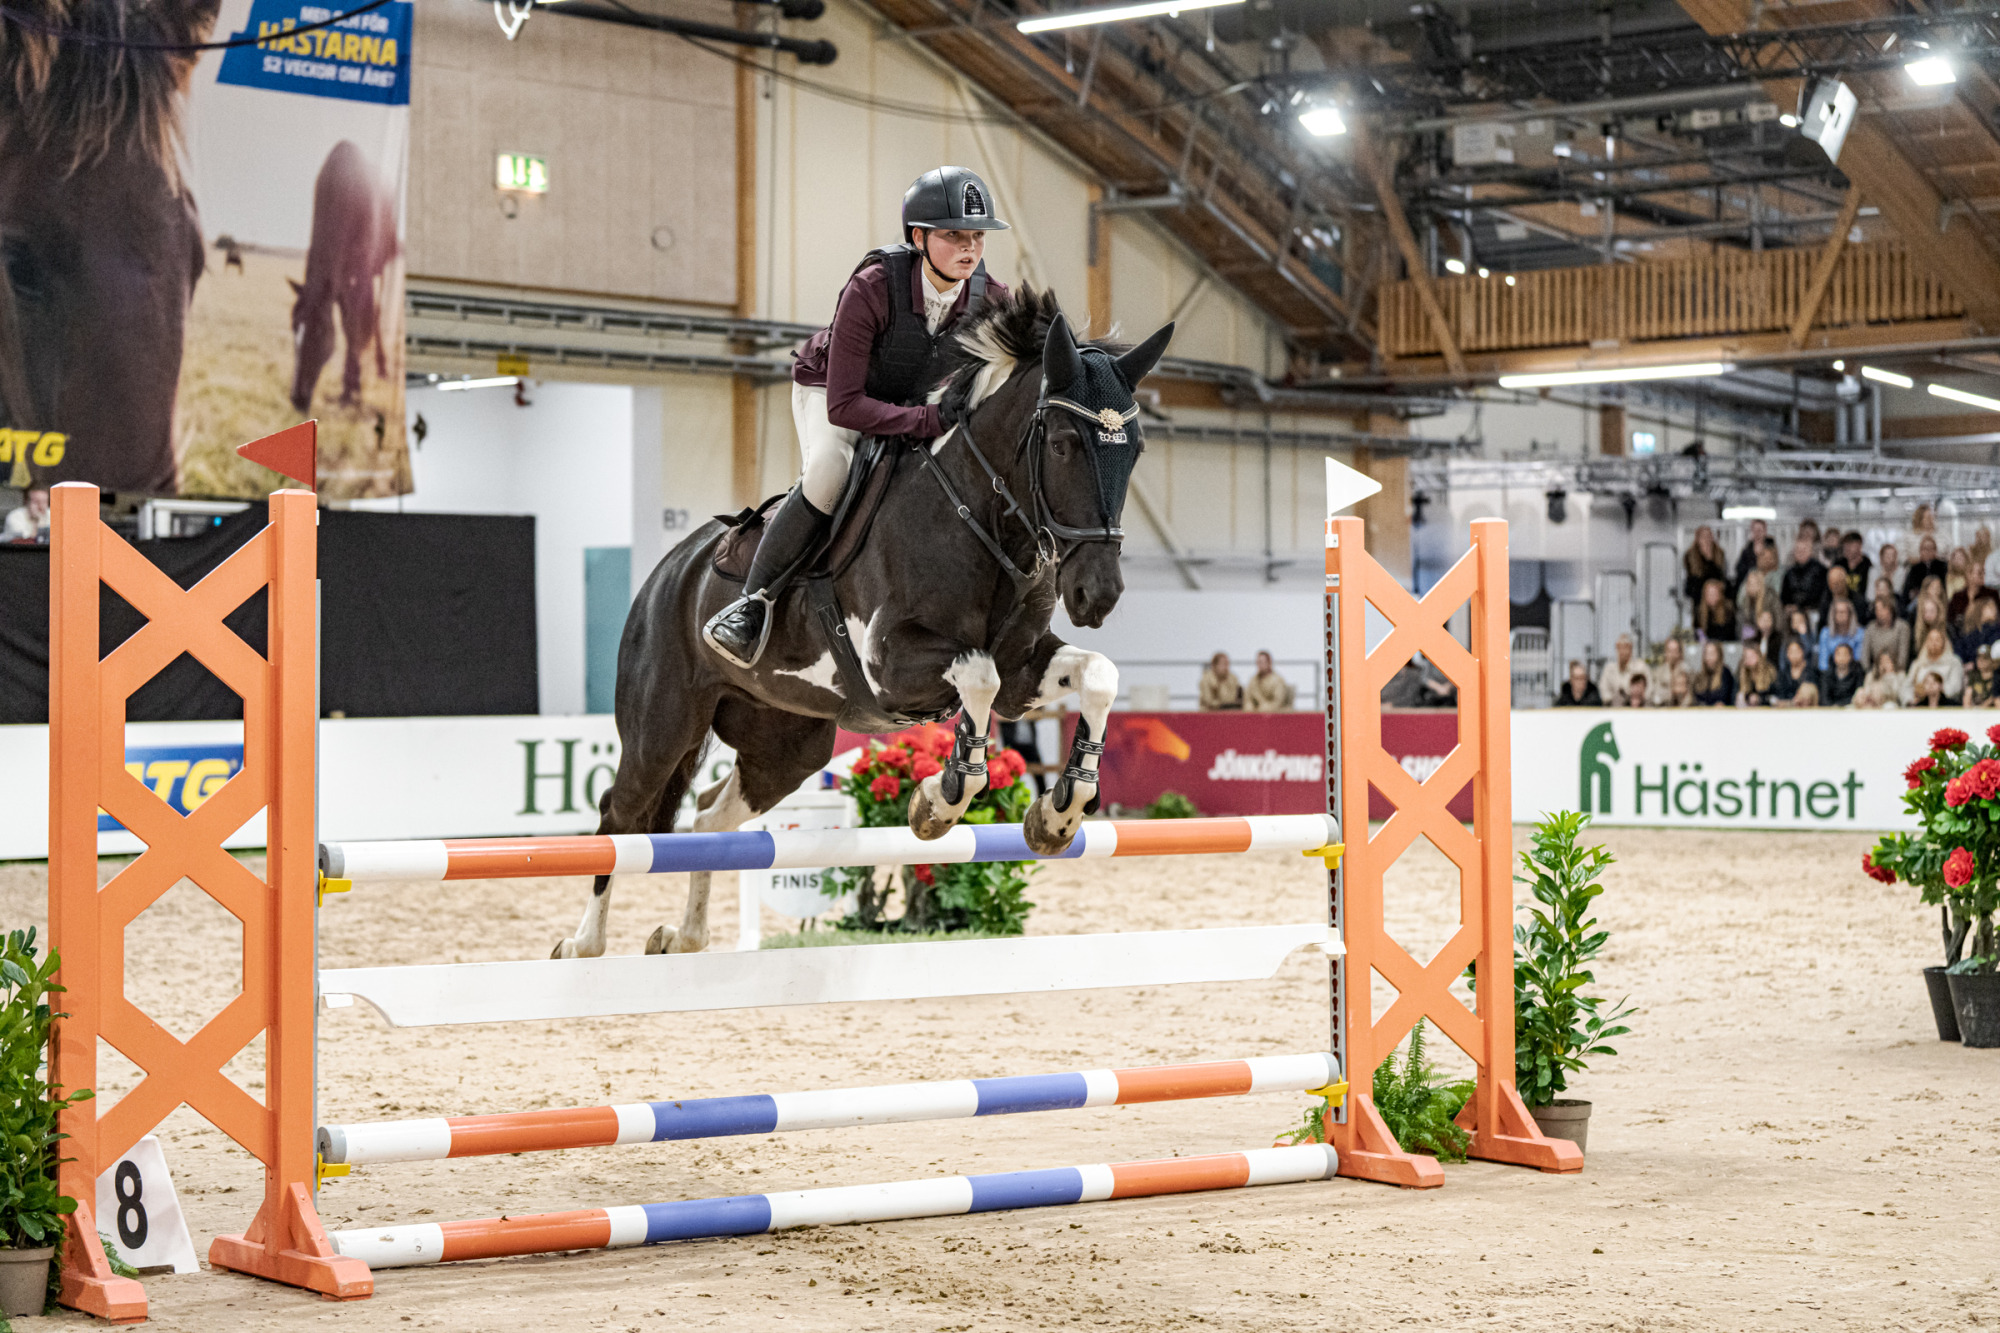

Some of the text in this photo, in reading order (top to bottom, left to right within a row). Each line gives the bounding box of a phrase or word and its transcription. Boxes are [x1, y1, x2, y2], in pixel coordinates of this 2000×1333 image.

[361, 11, 389, 33] FÖR
[258, 18, 397, 66] HÄSTARNA
[284, 58, 337, 80] VECKOR
[339, 66, 361, 83] OM
[1207, 748, 1323, 782] JÖNKÖPING
[1634, 762, 1864, 819] Hästnet
[771, 875, 820, 889] FINIS
[115, 1159, 148, 1249] 8
